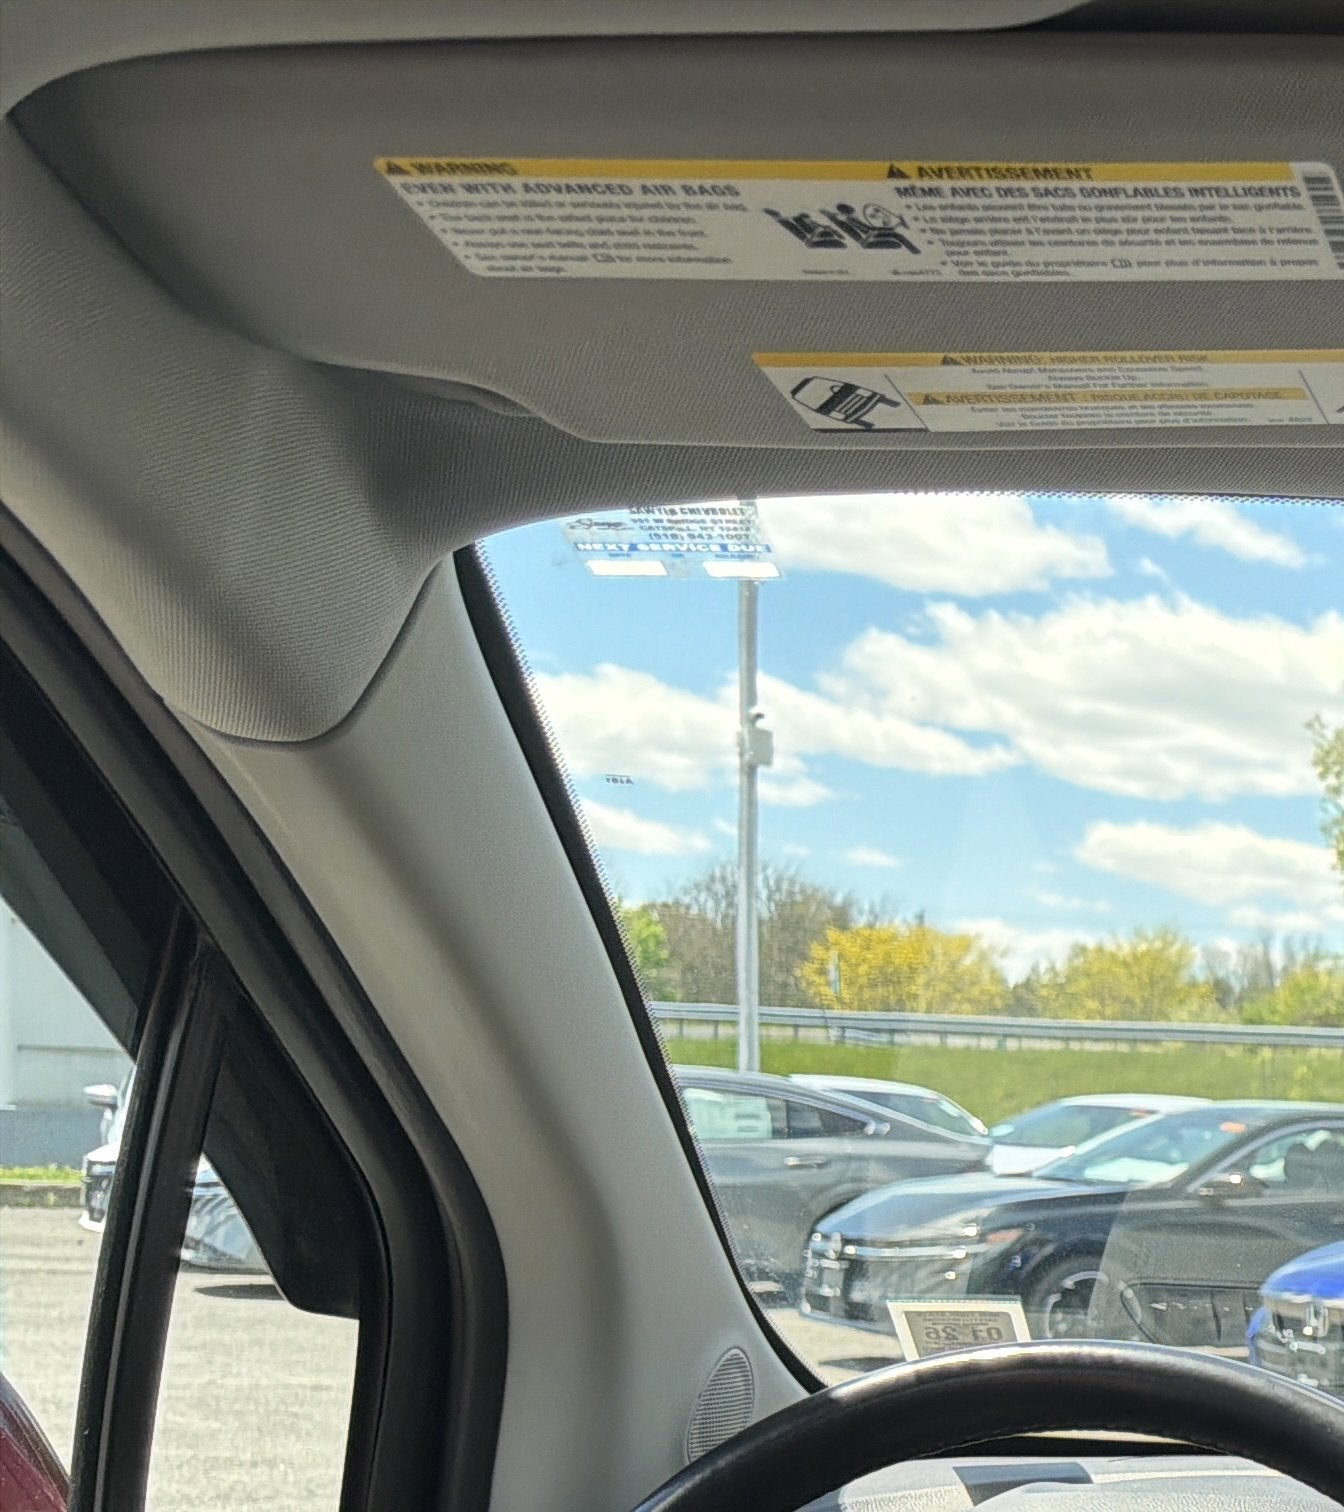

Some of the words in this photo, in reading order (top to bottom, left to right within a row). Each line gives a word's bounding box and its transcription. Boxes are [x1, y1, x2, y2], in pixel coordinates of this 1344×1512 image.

[412, 161, 518, 176] WARNING
[917, 166, 1093, 180] AVERTISSEMENT
[400, 182, 455, 195] EVEN
[461, 182, 516, 195] WITH
[521, 183, 633, 196] ADVANCED
[640, 184, 676, 196] AIR
[681, 184, 740, 197] BAGS
[951, 186, 992, 198] AVEC
[995, 186, 1029, 198] DES
[1031, 186, 1076, 198] SACS
[1188, 186, 1301, 198] INTELLIGENTS
[577, 543, 630, 551] NEXT
[636, 543, 719, 551] SERVICE
